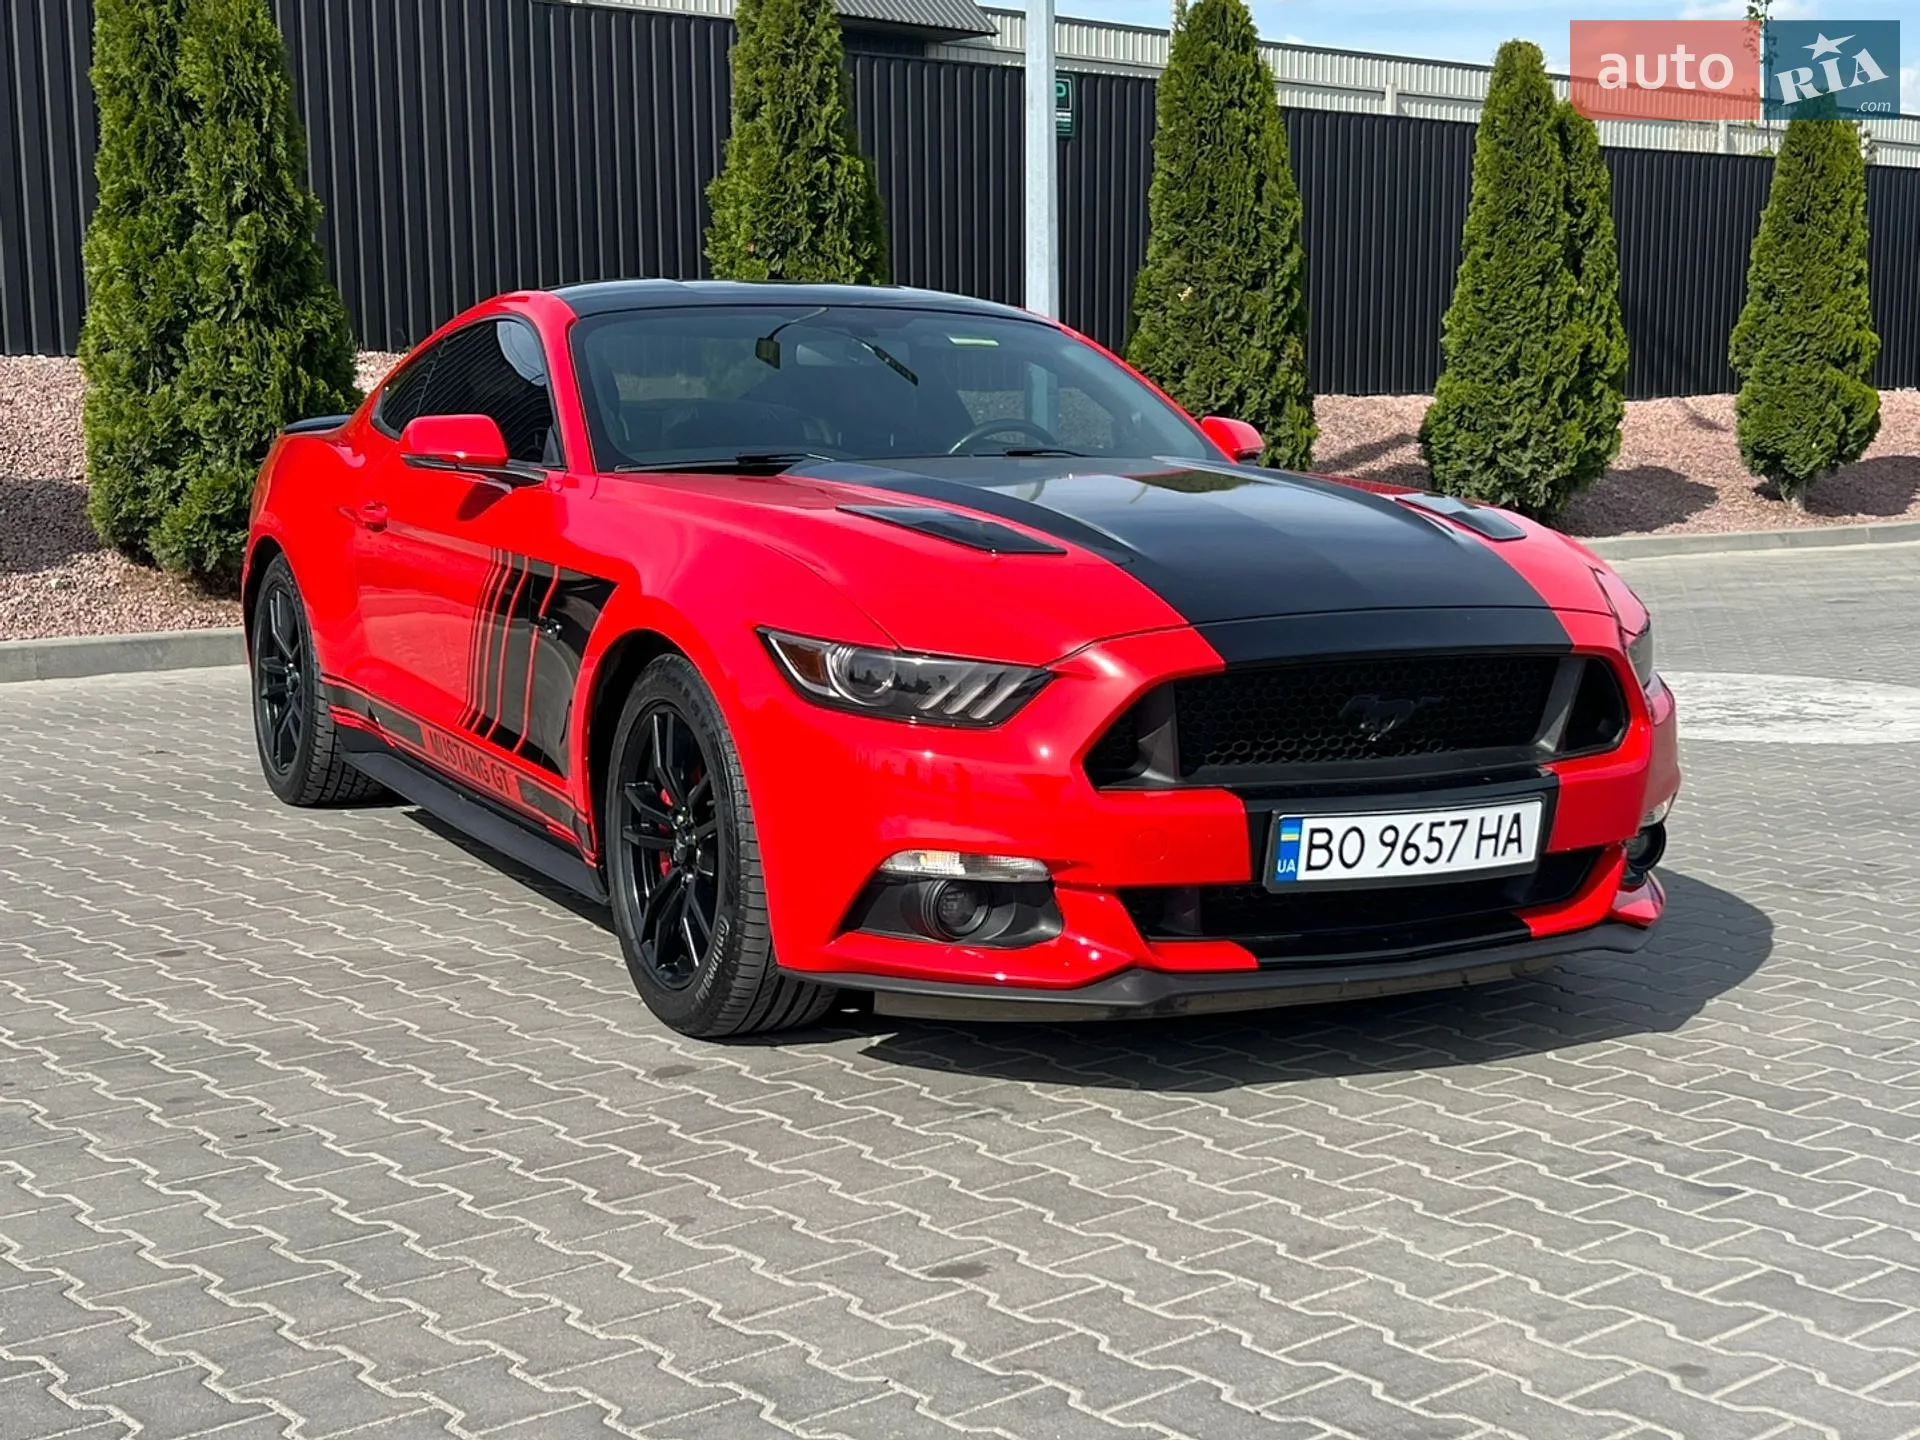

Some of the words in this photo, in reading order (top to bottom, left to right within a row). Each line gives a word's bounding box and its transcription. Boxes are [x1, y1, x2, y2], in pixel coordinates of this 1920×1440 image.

[491, 763, 511, 795] GT
[1305, 825, 1366, 873] BO
[1376, 817, 1469, 869] 9657
[1474, 811, 1524, 860] HA
[1276, 858, 1296, 874] UA
